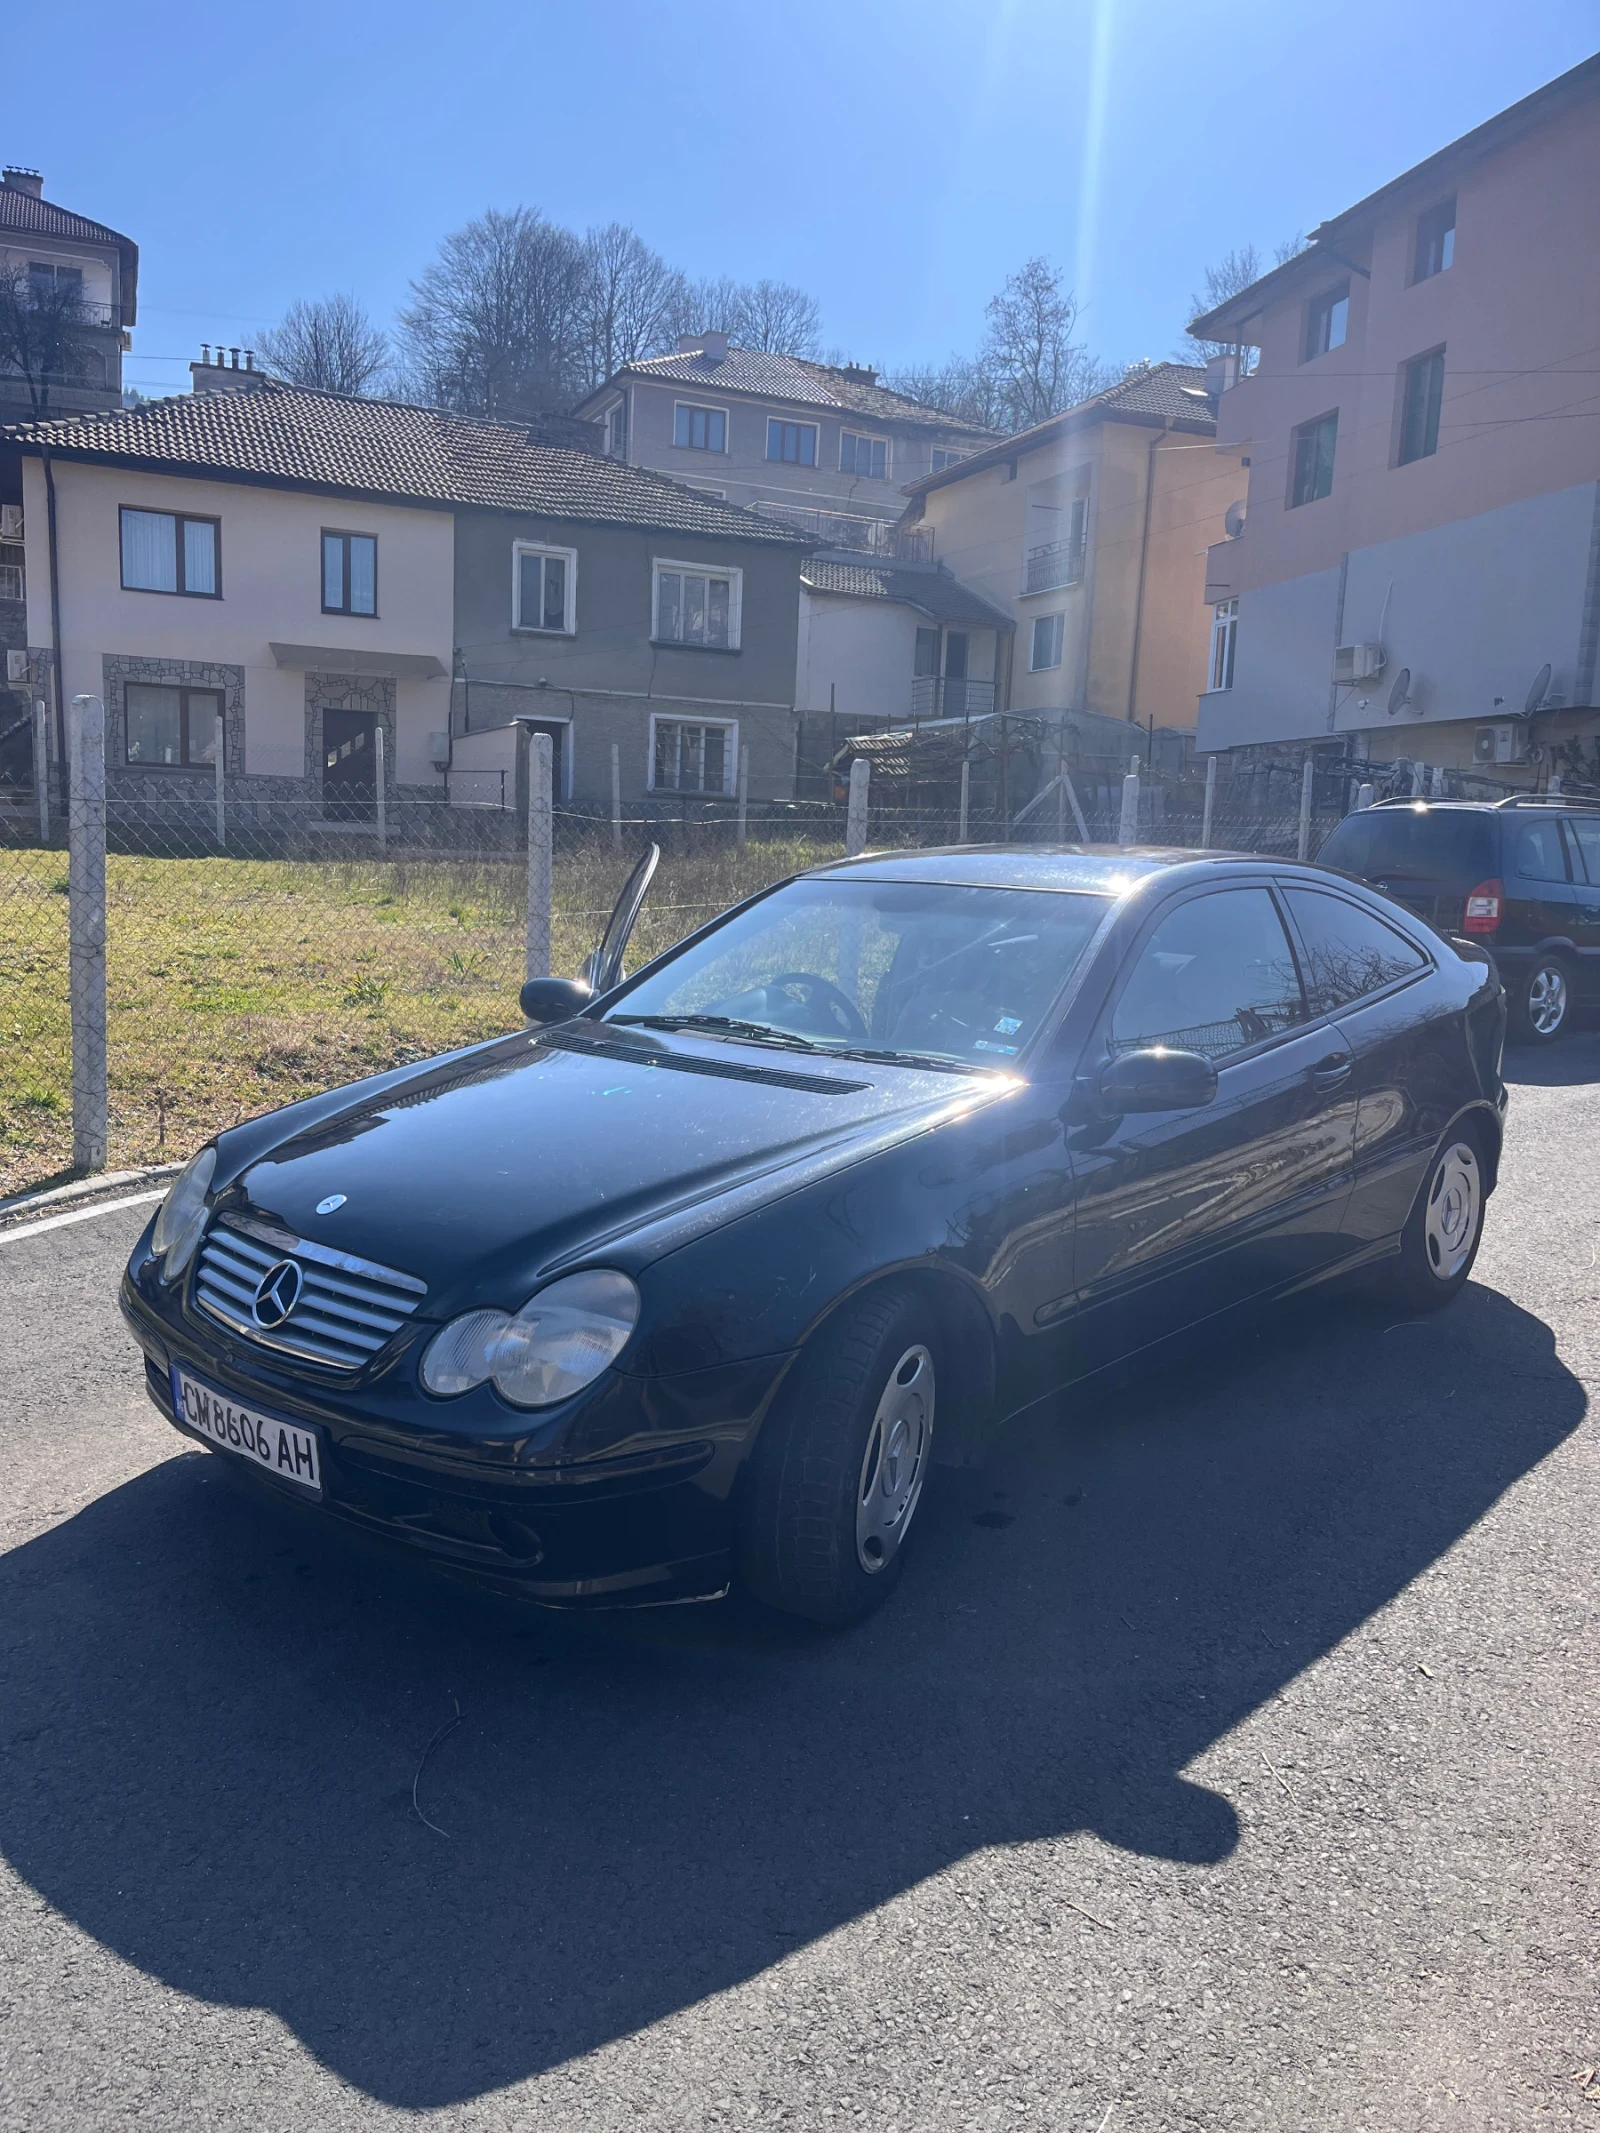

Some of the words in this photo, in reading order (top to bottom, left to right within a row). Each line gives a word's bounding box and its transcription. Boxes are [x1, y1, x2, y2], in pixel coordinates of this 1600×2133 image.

[183, 1381, 211, 1433] CM
[213, 1399, 271, 1461] 8606
[278, 1428, 315, 1481] AH
